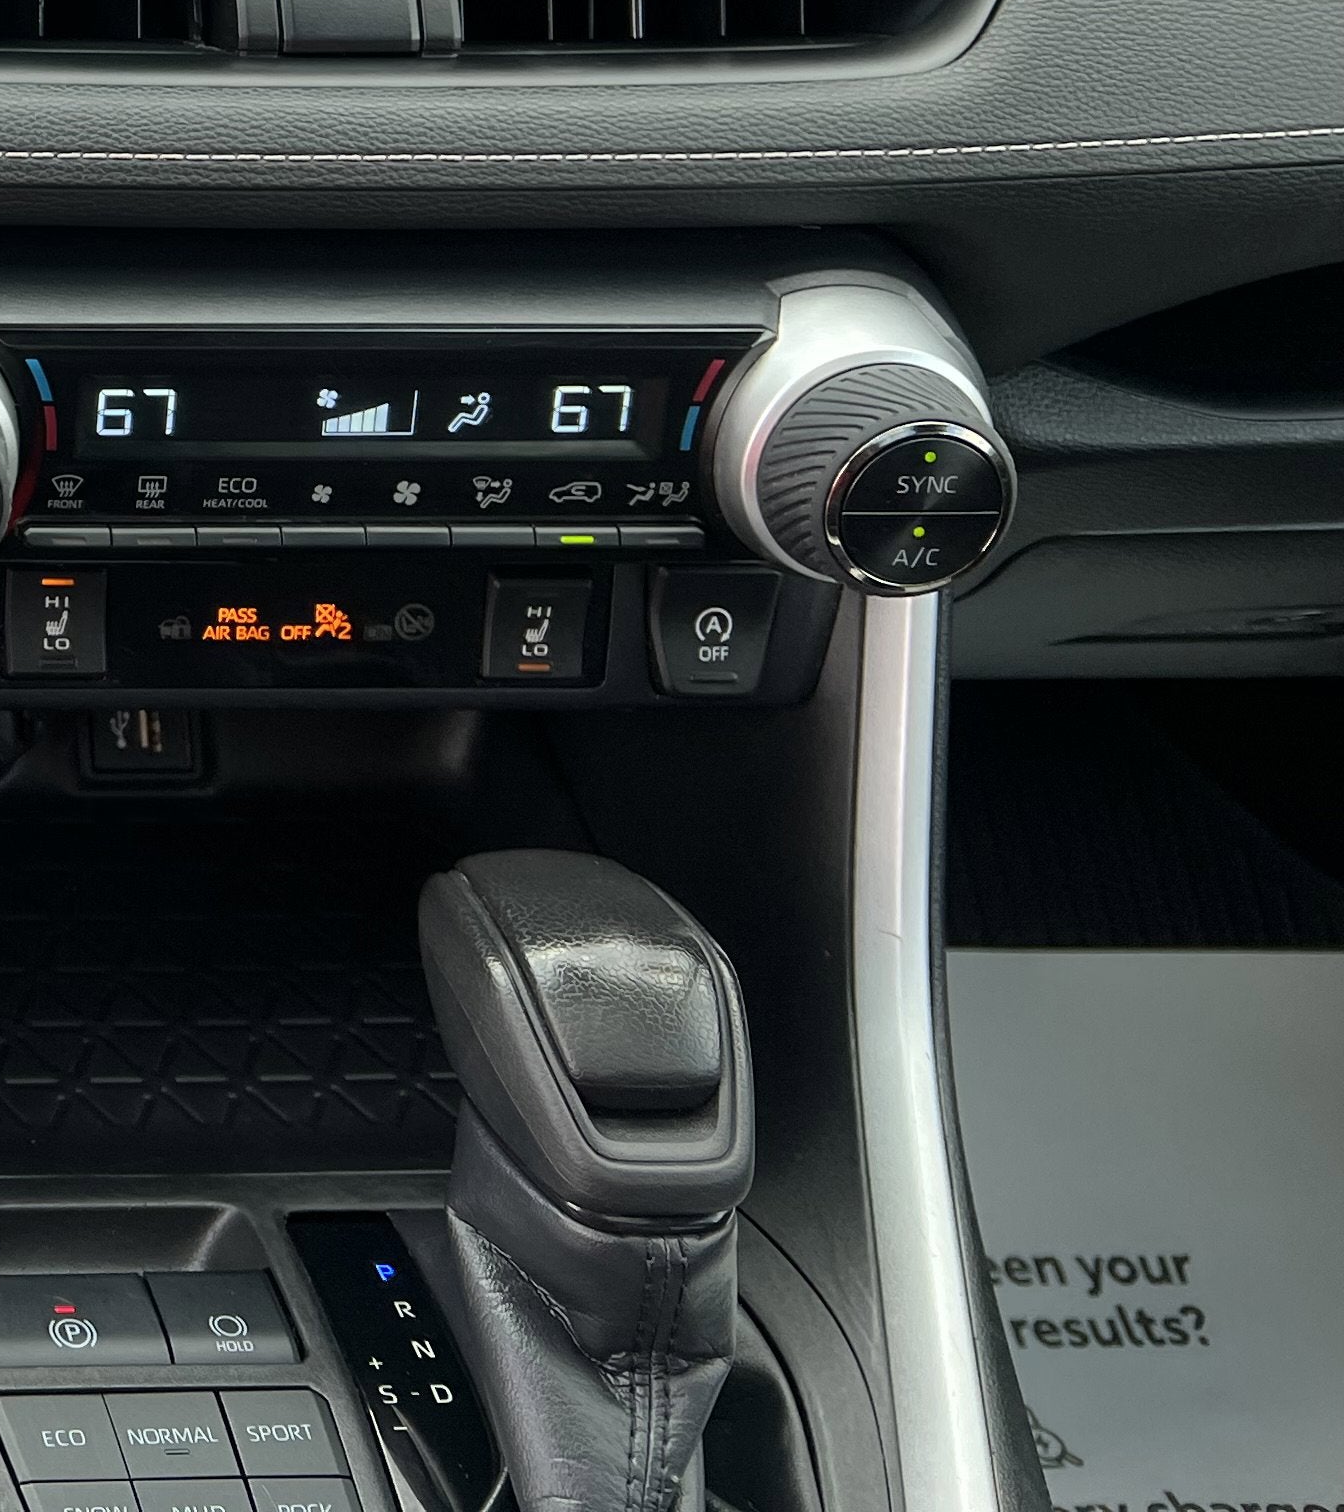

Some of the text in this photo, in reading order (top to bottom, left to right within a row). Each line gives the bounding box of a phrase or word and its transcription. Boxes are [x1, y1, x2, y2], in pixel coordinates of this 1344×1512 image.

[97, 389, 176, 436] 67
[551, 386, 632, 433] 67
[219, 478, 257, 493] ECO
[897, 476, 958, 493] SYNC
[48, 500, 83, 508] FRONT
[136, 500, 164, 509] REAR
[203, 499, 267, 508] HEAT/COOL
[892, 547, 939, 568] A/C
[45, 596, 68, 608] HI
[218, 608, 257, 623] PASS
[527, 607, 551, 617] HI
[203, 626, 231, 640] AIR
[236, 626, 269, 640] BAG
[281, 625, 311, 640] OFF
[44, 638, 69, 650] LO
[522, 644, 548, 656] LO
[699, 646, 728, 661] OFF
[376, 1265, 395, 1282] P
[1075, 1254, 1189, 1296] your
[394, 1301, 415, 1317] R
[1010, 1304, 1210, 1349] results?
[216, 1341, 253, 1351] HOLD
[412, 1341, 435, 1358] N
[379, 1385, 397, 1403] S
[430, 1385, 452, 1403] D
[42, 1430, 85, 1447] ECO
[127, 1427, 218, 1444] NORMAL
[247, 1424, 311, 1441] SPORT
